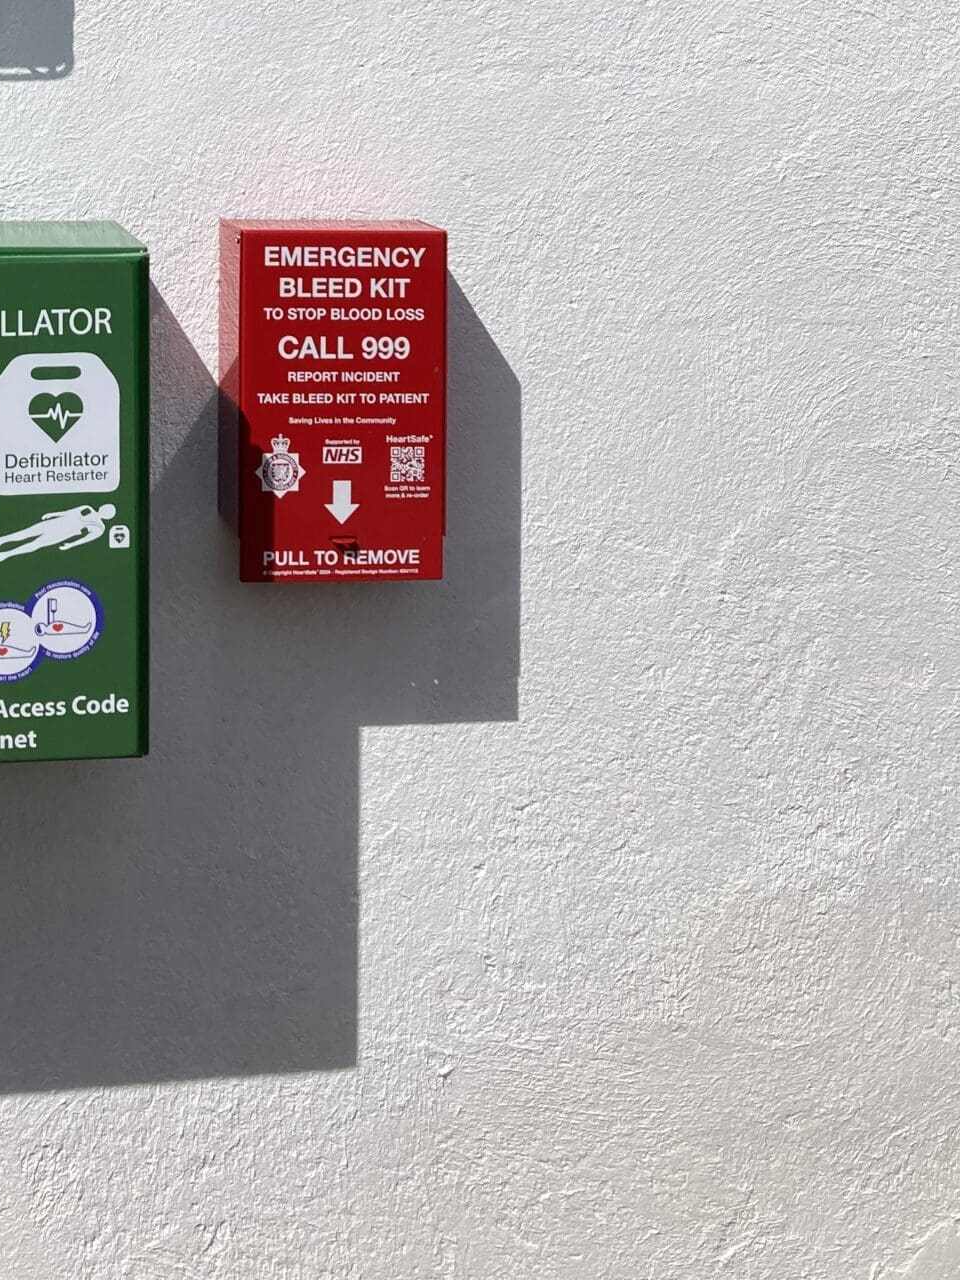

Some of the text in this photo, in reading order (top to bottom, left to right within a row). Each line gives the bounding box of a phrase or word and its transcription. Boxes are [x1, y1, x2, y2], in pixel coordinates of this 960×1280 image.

[264, 246, 426, 267] EMERGENCY
[279, 278, 410, 298] BLEED KIT
[264, 308, 424, 320] TO STOP BLOOD LOSS
[278, 336, 410, 360] CALL 999
[288, 372, 400, 382] REPORT INCIDENT
[257, 393, 429, 404] TAKE BLEED KIT TO PATIENT
[289, 417, 312, 425] Saving
[356, 417, 396, 425] Community
[5, 452, 108, 469] Defibrillator
[325, 448, 359, 462] NHS
[5, 470, 108, 483] Heart Restarter
[263, 549, 420, 566] PULL TO REMOVE
[72, 694, 129, 715] Code
